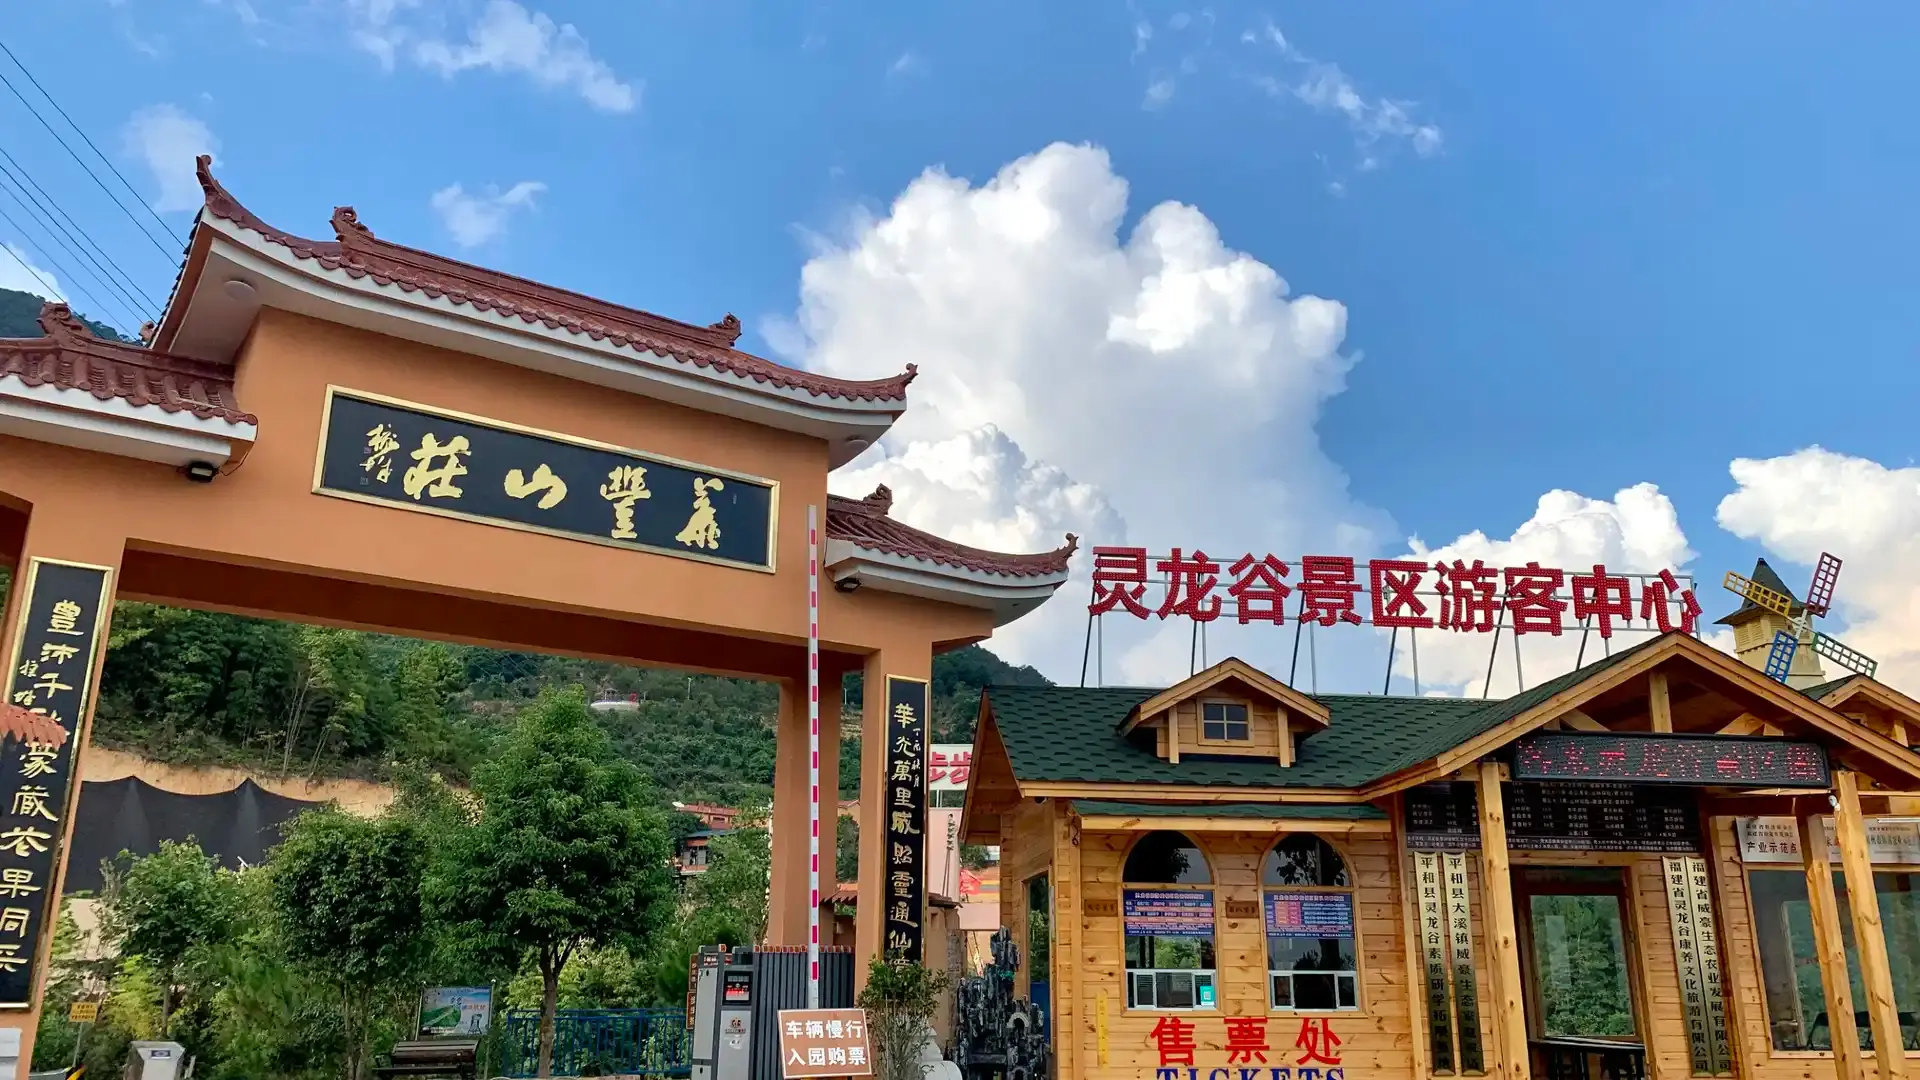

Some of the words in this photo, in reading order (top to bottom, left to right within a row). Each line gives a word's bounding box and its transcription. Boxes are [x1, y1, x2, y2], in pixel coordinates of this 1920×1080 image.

[1087, 545, 1704, 639] 灵龙谷景区游客中心
[1669, 861, 1709, 1072] 福建省灵龙谷康养文化旅游有限公司
[1692, 862, 1732, 1071] 福建省威豪生态农业发展有限公司
[785, 1019, 864, 1040] 车辆慢行
[787, 1046, 867, 1067] 入园购票
[1150, 1016, 1342, 1067] 售票处
